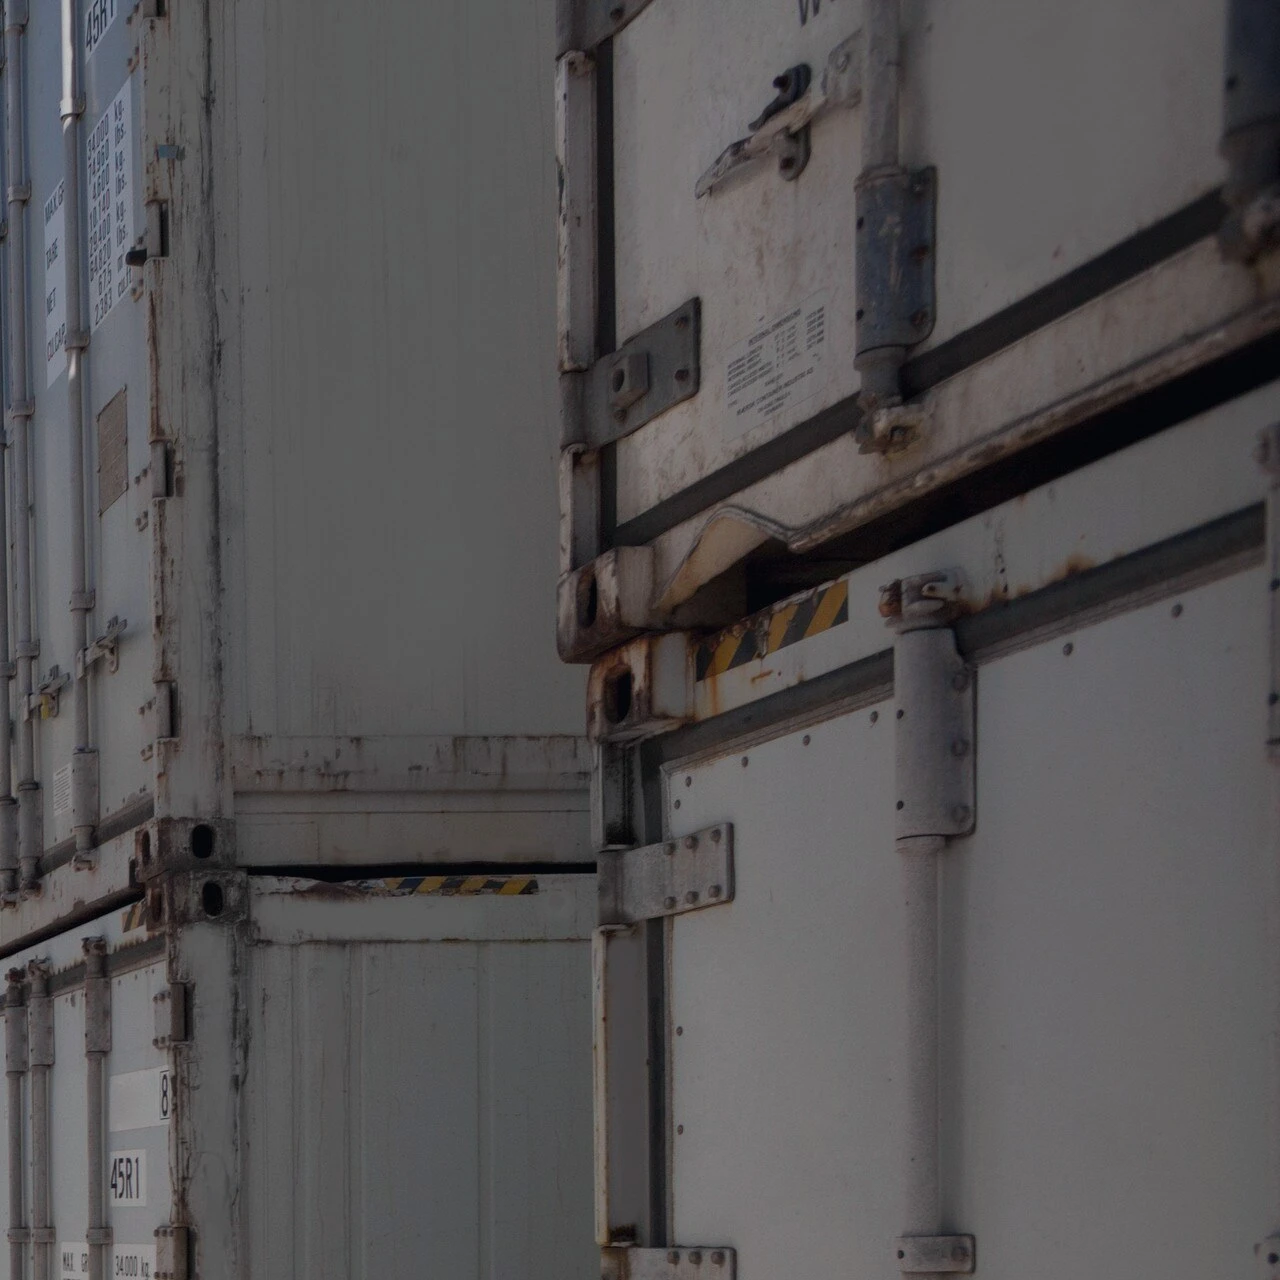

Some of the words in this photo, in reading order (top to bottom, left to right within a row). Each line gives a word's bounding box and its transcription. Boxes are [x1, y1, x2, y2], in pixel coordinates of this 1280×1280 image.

[88, 114, 109, 161] 34.000
[88, 139, 110, 185] 74.960
[161, 1073, 169, 1118] 8
[110, 1156, 140, 1200] 45R1
[115, 1255, 138, 1277] 34.000
